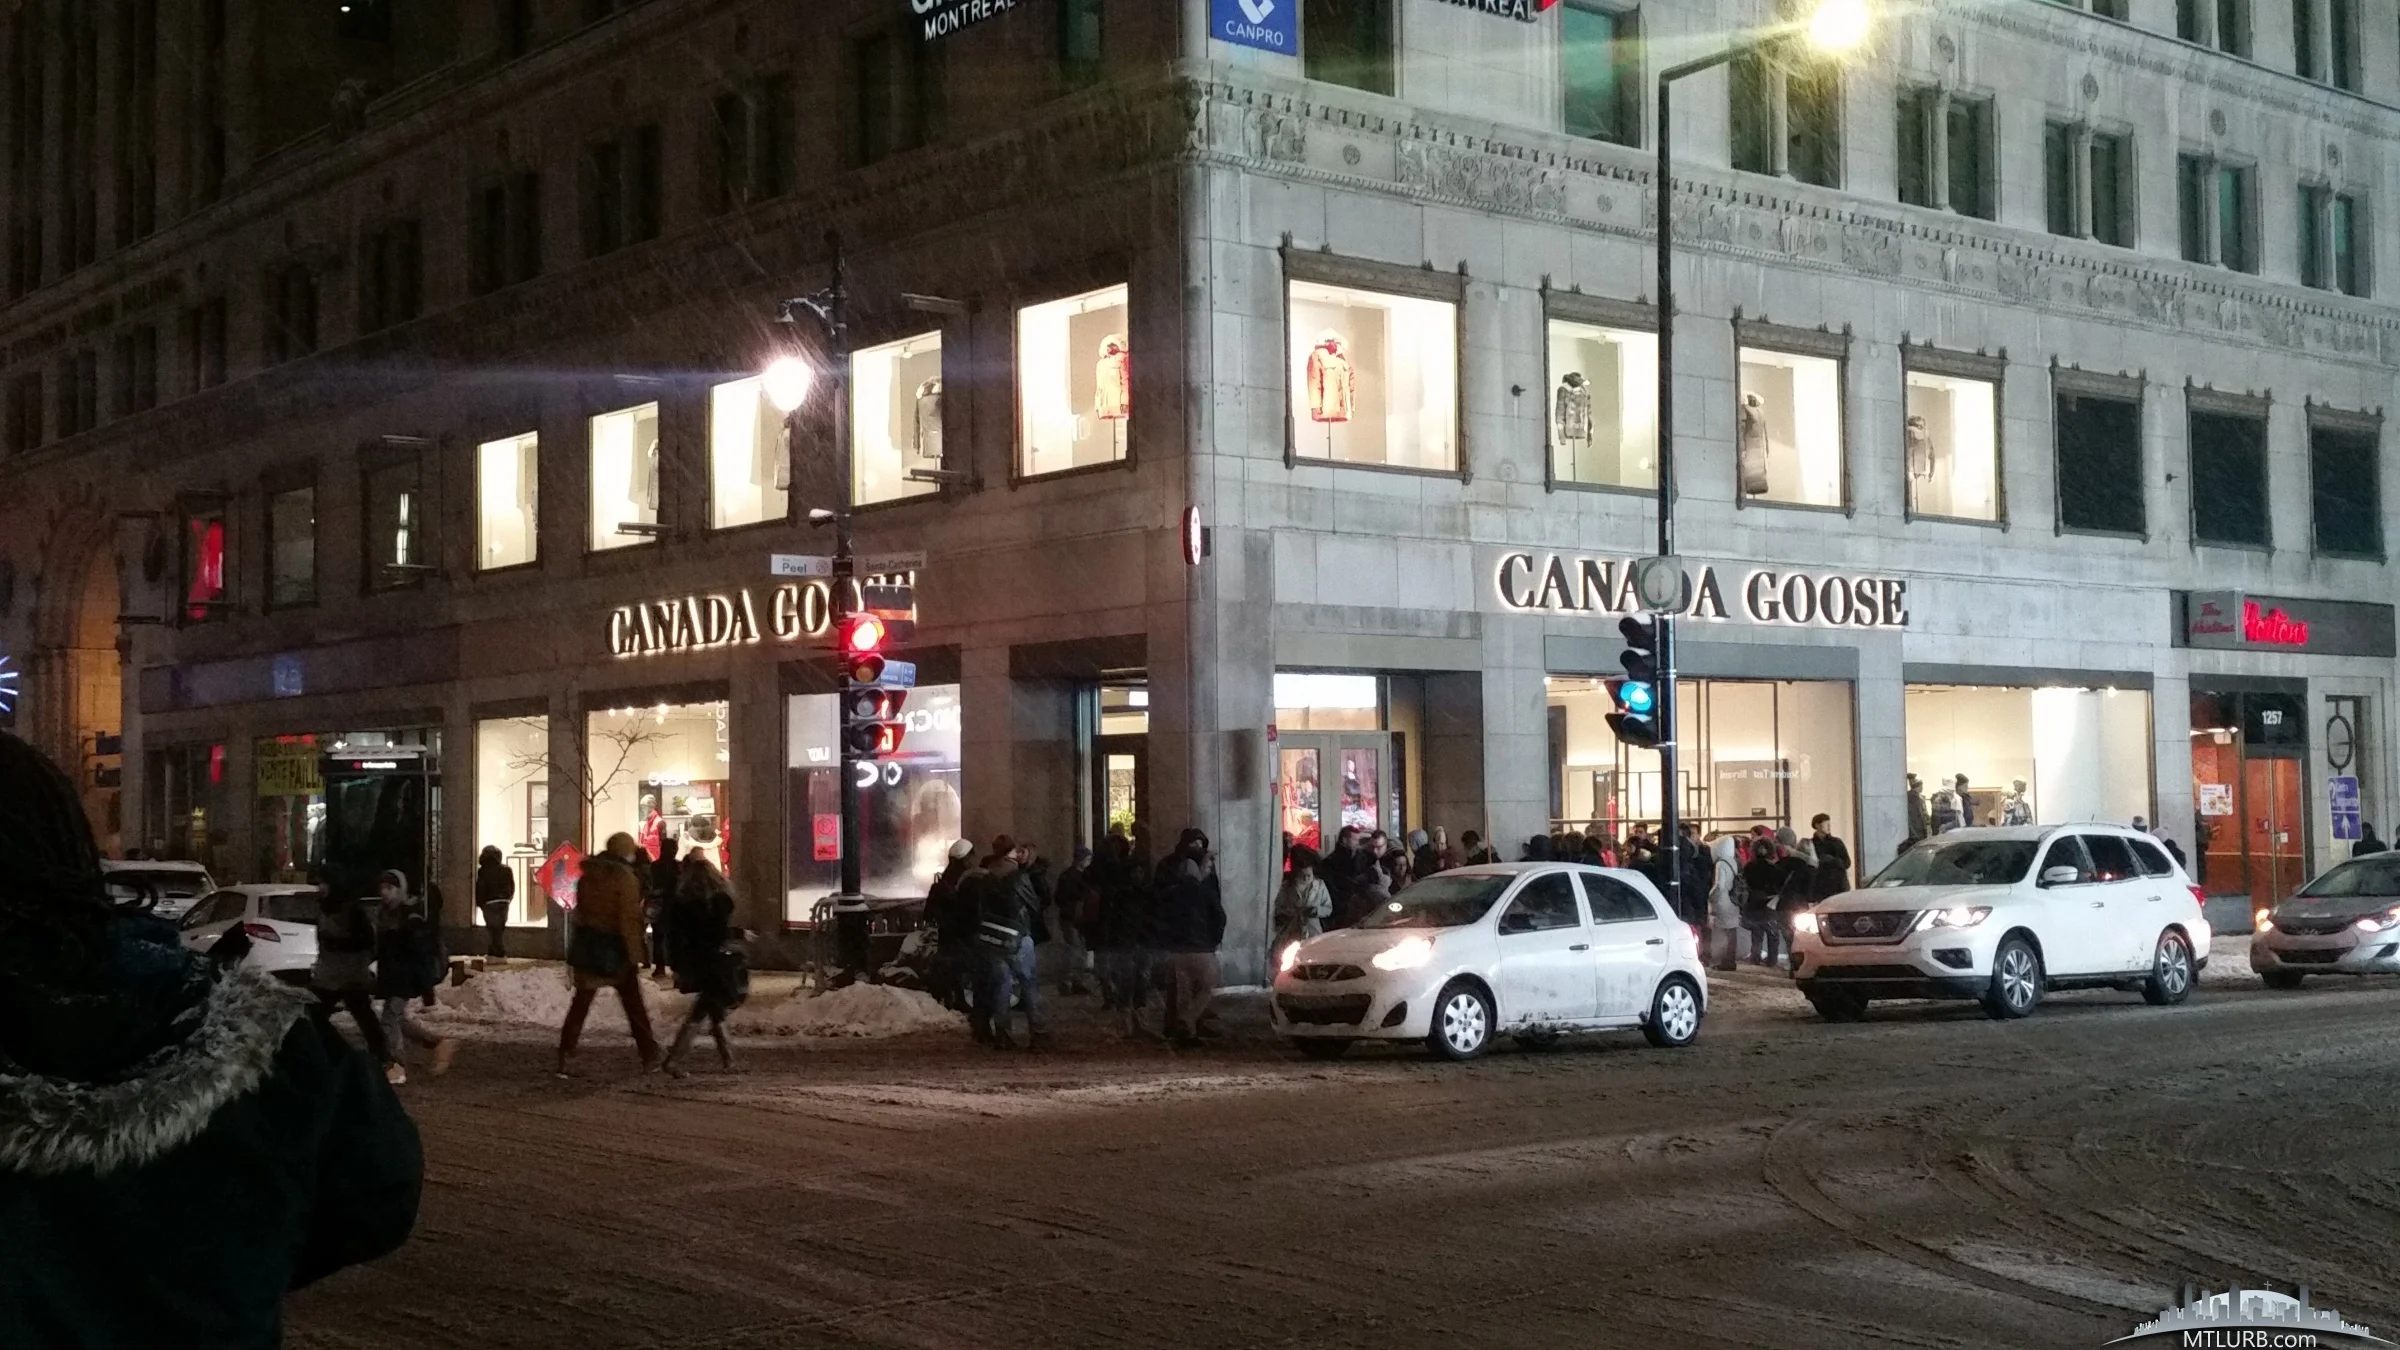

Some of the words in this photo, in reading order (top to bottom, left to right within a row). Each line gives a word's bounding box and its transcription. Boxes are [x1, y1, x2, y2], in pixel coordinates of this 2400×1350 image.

[1225, 20, 1284, 46] CANPRO
[782, 562, 807, 574] Peel
[1496, 553, 1732, 619] CANAA
[1746, 570, 1910, 628] GOOSE
[604, 588, 760, 657] CANADA
[767, 570, 917, 638] GOO
[2262, 710, 2283, 724] 1257
